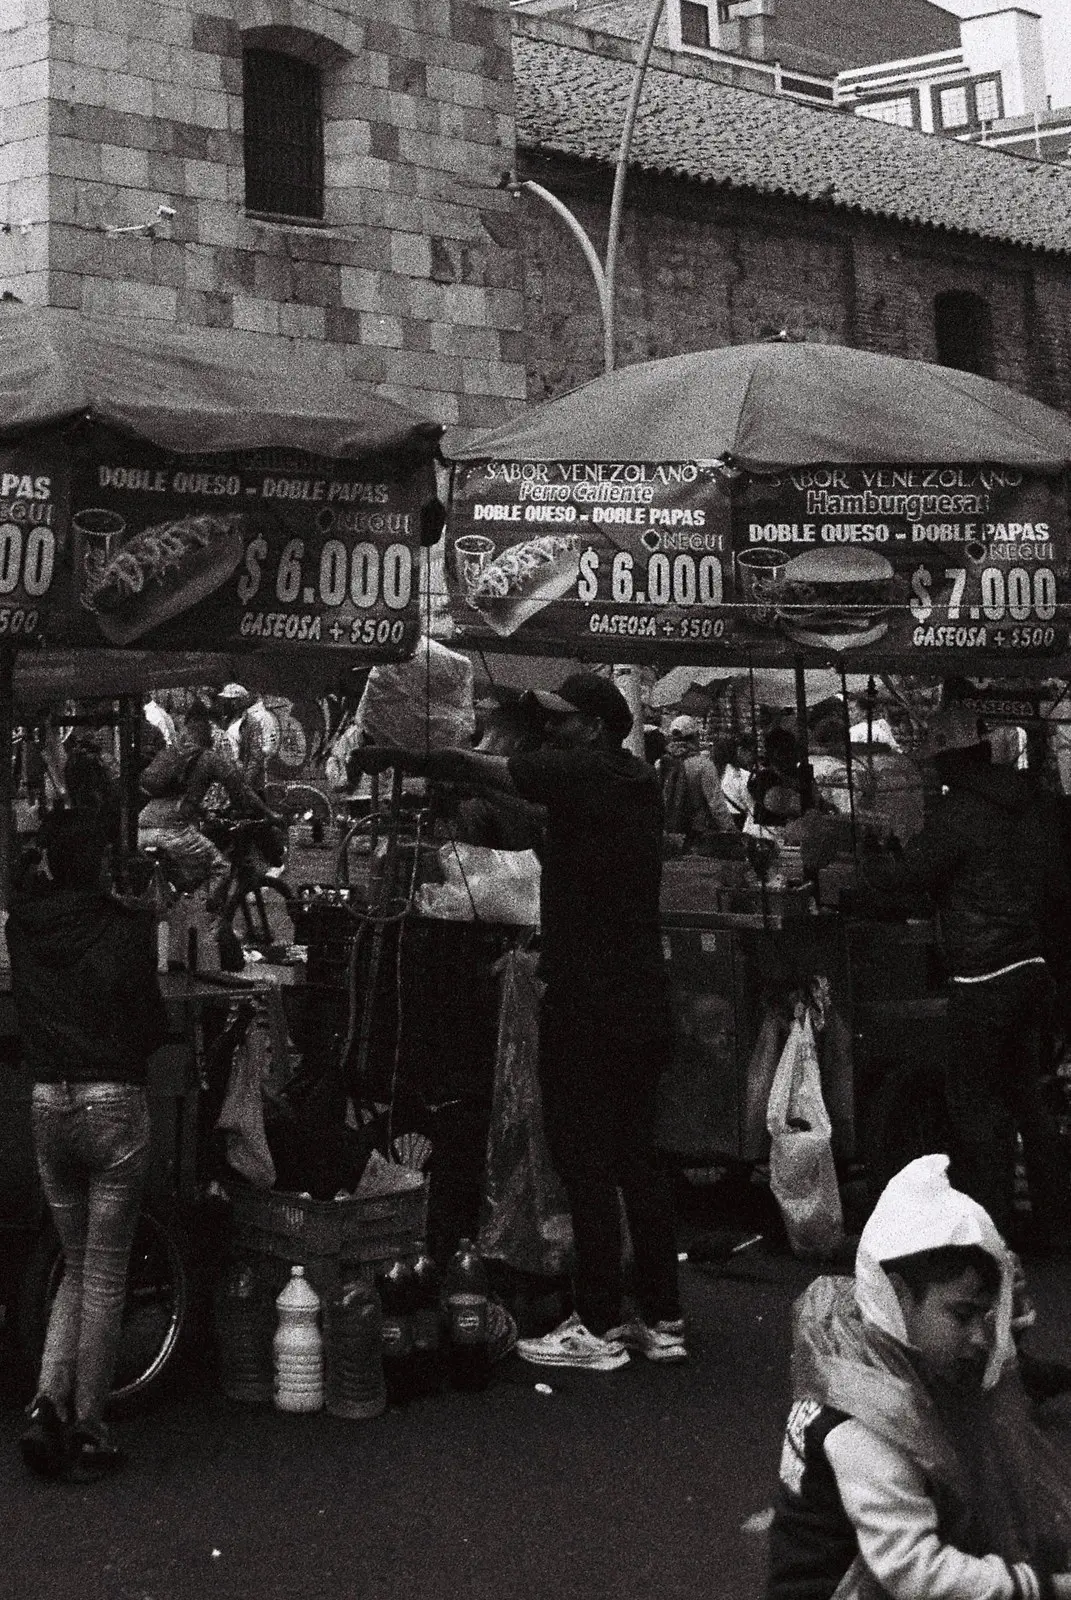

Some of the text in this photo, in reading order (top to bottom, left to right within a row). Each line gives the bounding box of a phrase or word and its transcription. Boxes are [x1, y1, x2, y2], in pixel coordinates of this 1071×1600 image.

[99, 465, 167, 492] DOBLE
[173, 471, 241, 496] QUESO
[262, 478, 326, 501] DOBLE
[328, 482, 389, 503] PAPAS
[484, 463, 698, 485] SABOR VENEZOLANO
[861, 470, 1022, 490] VENEZOLANO
[518, 480, 655, 504] Perro Caliente
[474, 504, 522, 521] DOBLE
[524, 505, 577, 522] QUESO
[592, 506, 646, 524] DOBLE
[649, 508, 706, 526] PAPAS
[663, 531, 725, 552] NEQUI
[749, 523, 816, 542] DOBLE
[821, 523, 890, 542] QUESO
[911, 523, 977, 542] DOBLE
[981, 522, 1050, 541] PAPAS
[989, 542, 1054, 561] NEQUI
[240, 612, 322, 640] GASEOSA
[350, 618, 405, 643] $500
[589, 613, 657, 637] GASEOSA
[680, 618, 725, 638] $500
[913, 626, 988, 647] GASEOSA
[1011, 627, 1055, 647] $500
